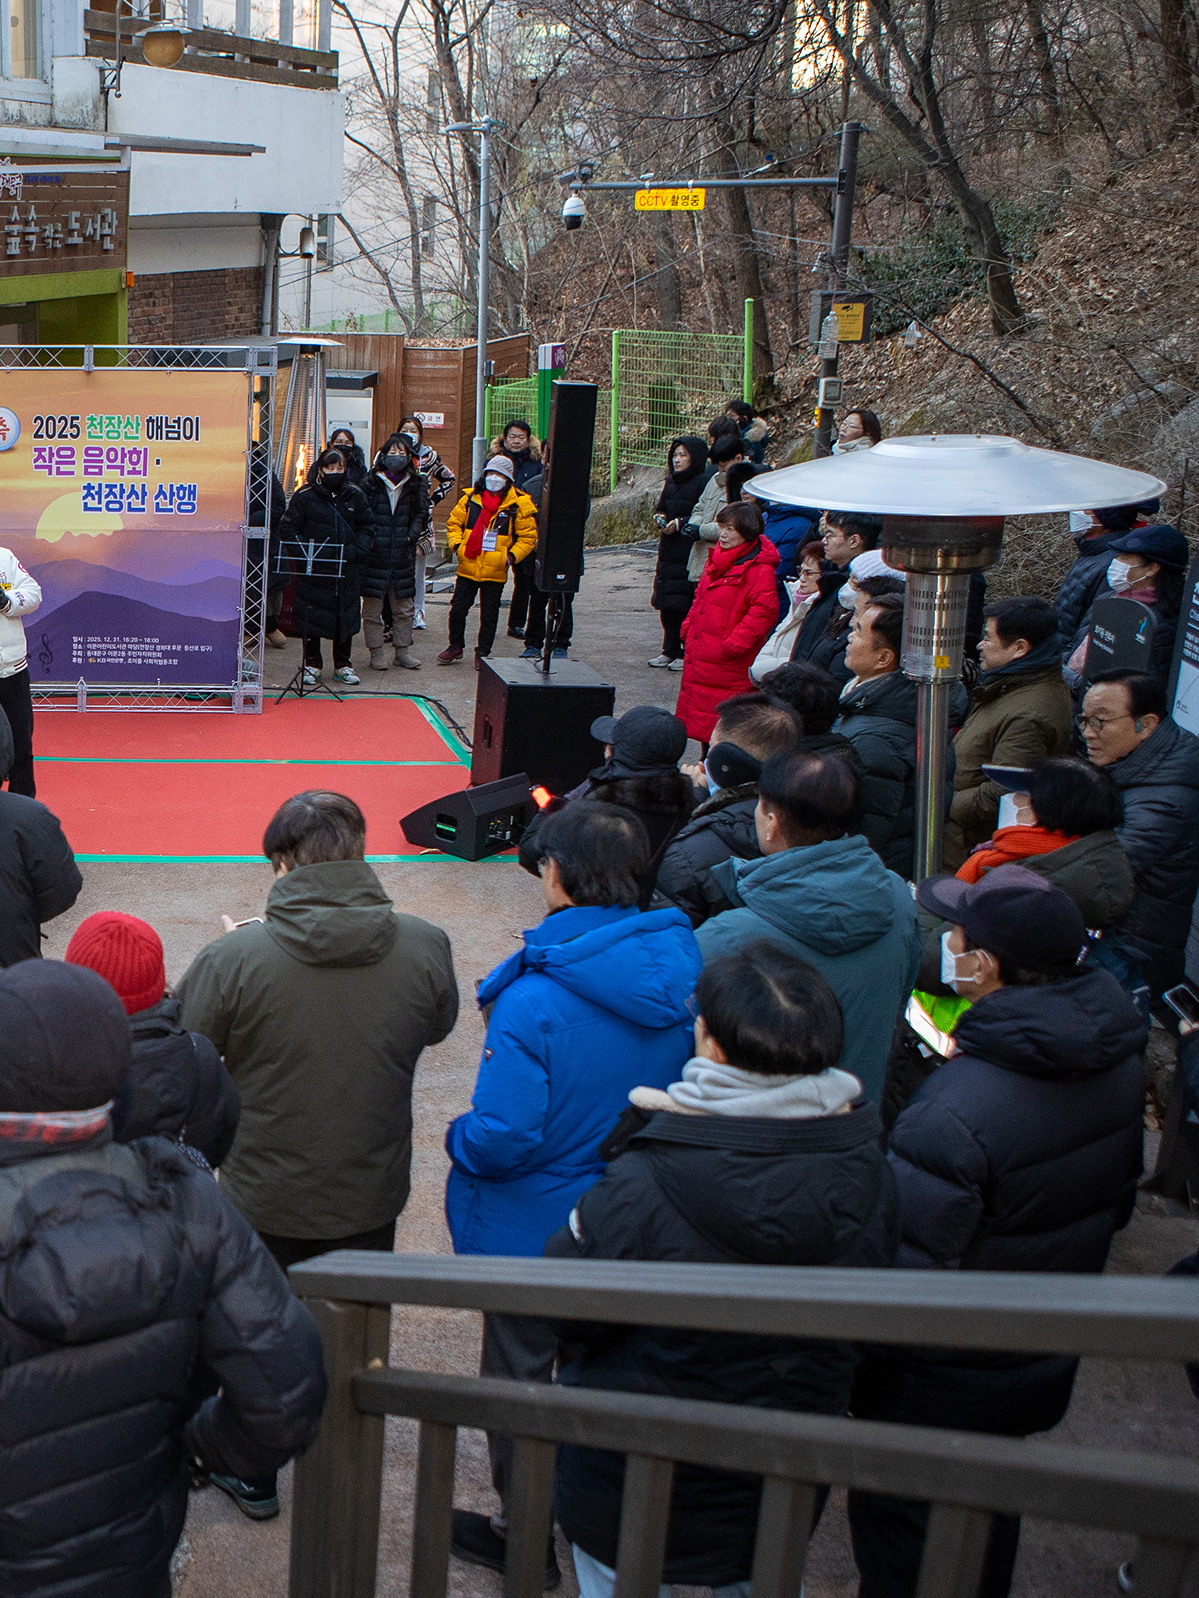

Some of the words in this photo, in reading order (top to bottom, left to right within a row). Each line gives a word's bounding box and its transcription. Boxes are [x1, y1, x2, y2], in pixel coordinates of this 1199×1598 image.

[639, 195, 668, 207] CCTV
[671, 194, 700, 207] 촬영중
[32, 415, 80, 440] 2025
[85, 414, 141, 441] 천장산
[146, 416, 200, 442] 해넘이
[33, 446, 76, 476] 작은
[81, 482, 148, 513] 천장산
[154, 483, 198, 515] 산행
